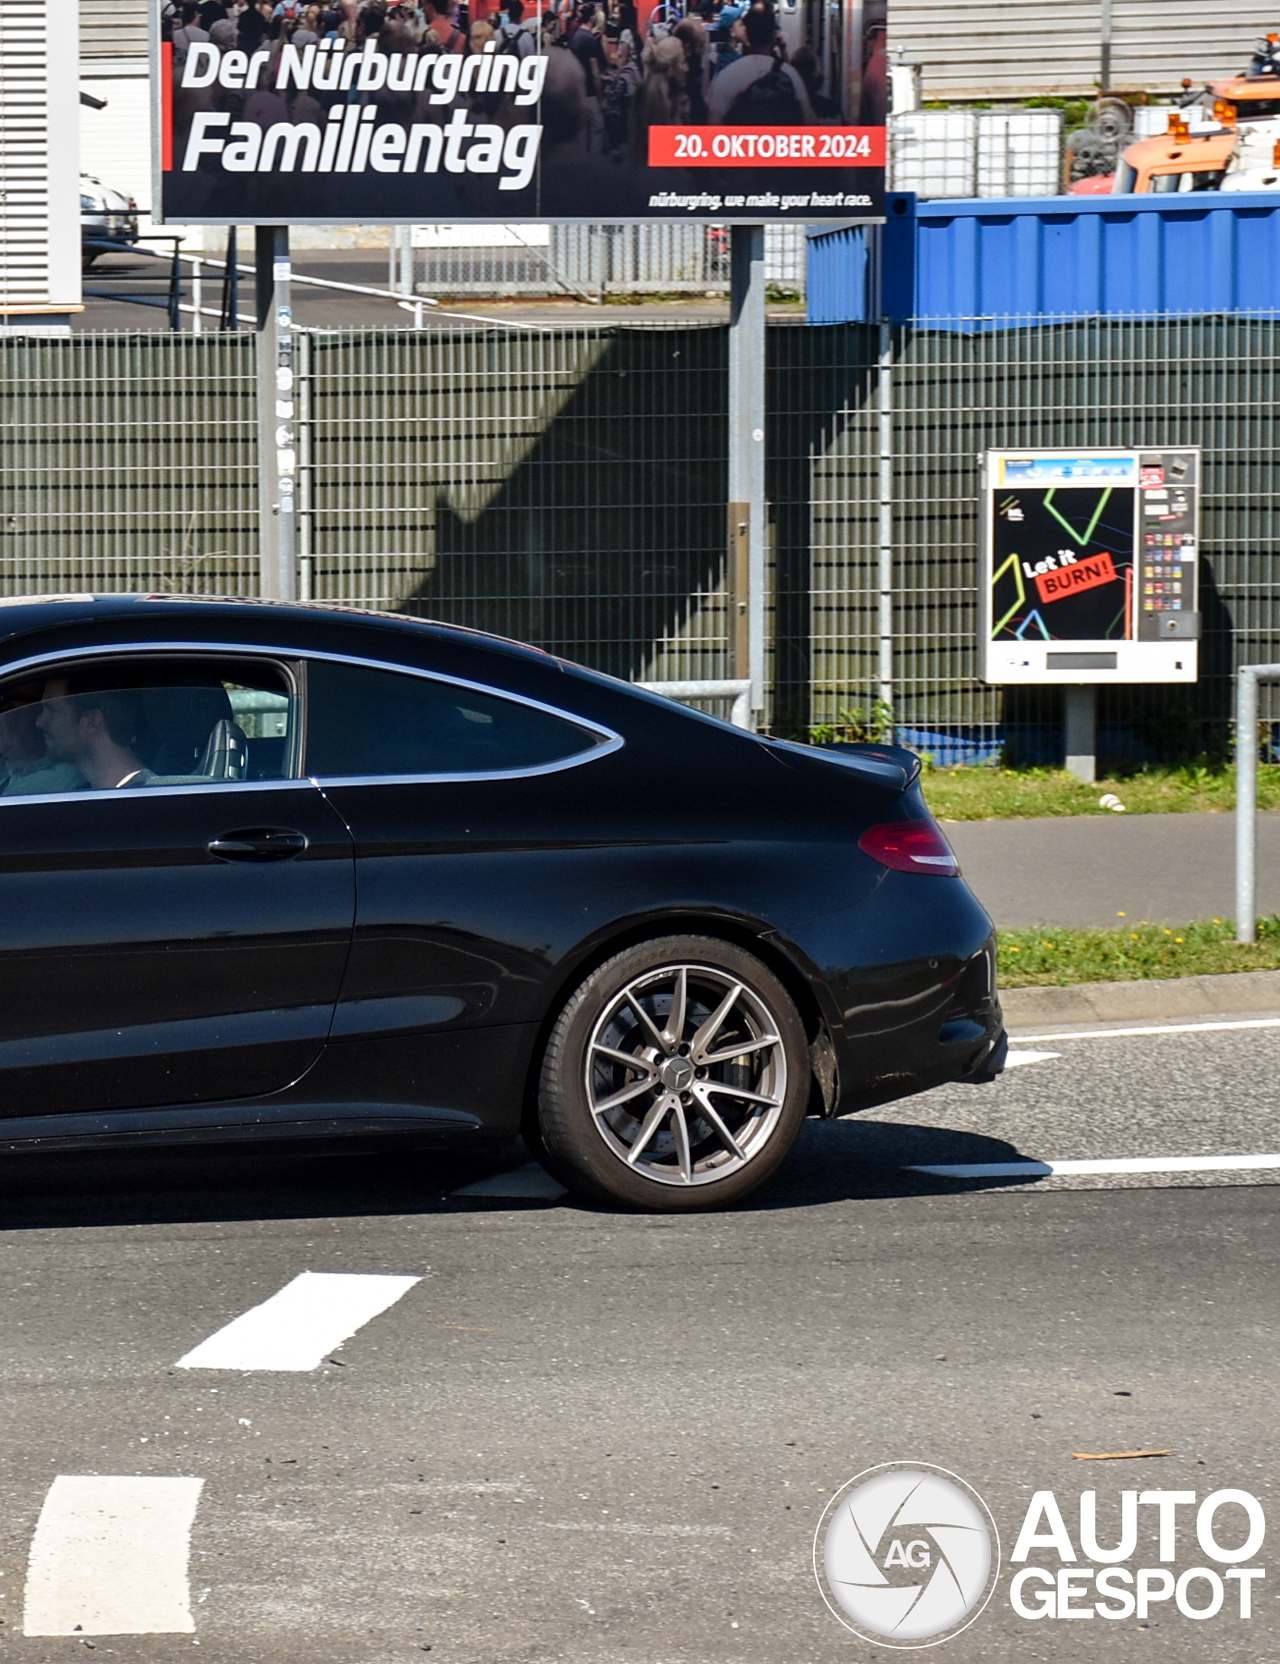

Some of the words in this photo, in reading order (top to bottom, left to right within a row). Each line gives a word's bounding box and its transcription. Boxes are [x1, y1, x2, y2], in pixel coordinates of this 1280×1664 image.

[181, 41, 270, 89] Der
[275, 38, 549, 106] Nürburgring
[182, 104, 543, 191] Familientag
[674, 134, 708, 158] 20.
[712, 134, 815, 158] OKTOBER
[818, 134, 871, 158] 2024
[648, 192, 723, 210] nürburgring.
[724, 195, 745, 207] we
[746, 192, 779, 207] make
[780, 195, 810, 210] your
[810, 192, 844, 207] heart
[844, 195, 873, 207] race.
[1022, 555, 1059, 578] Let
[1057, 549, 1078, 566] it
[1043, 560, 1110, 594] BURN!
